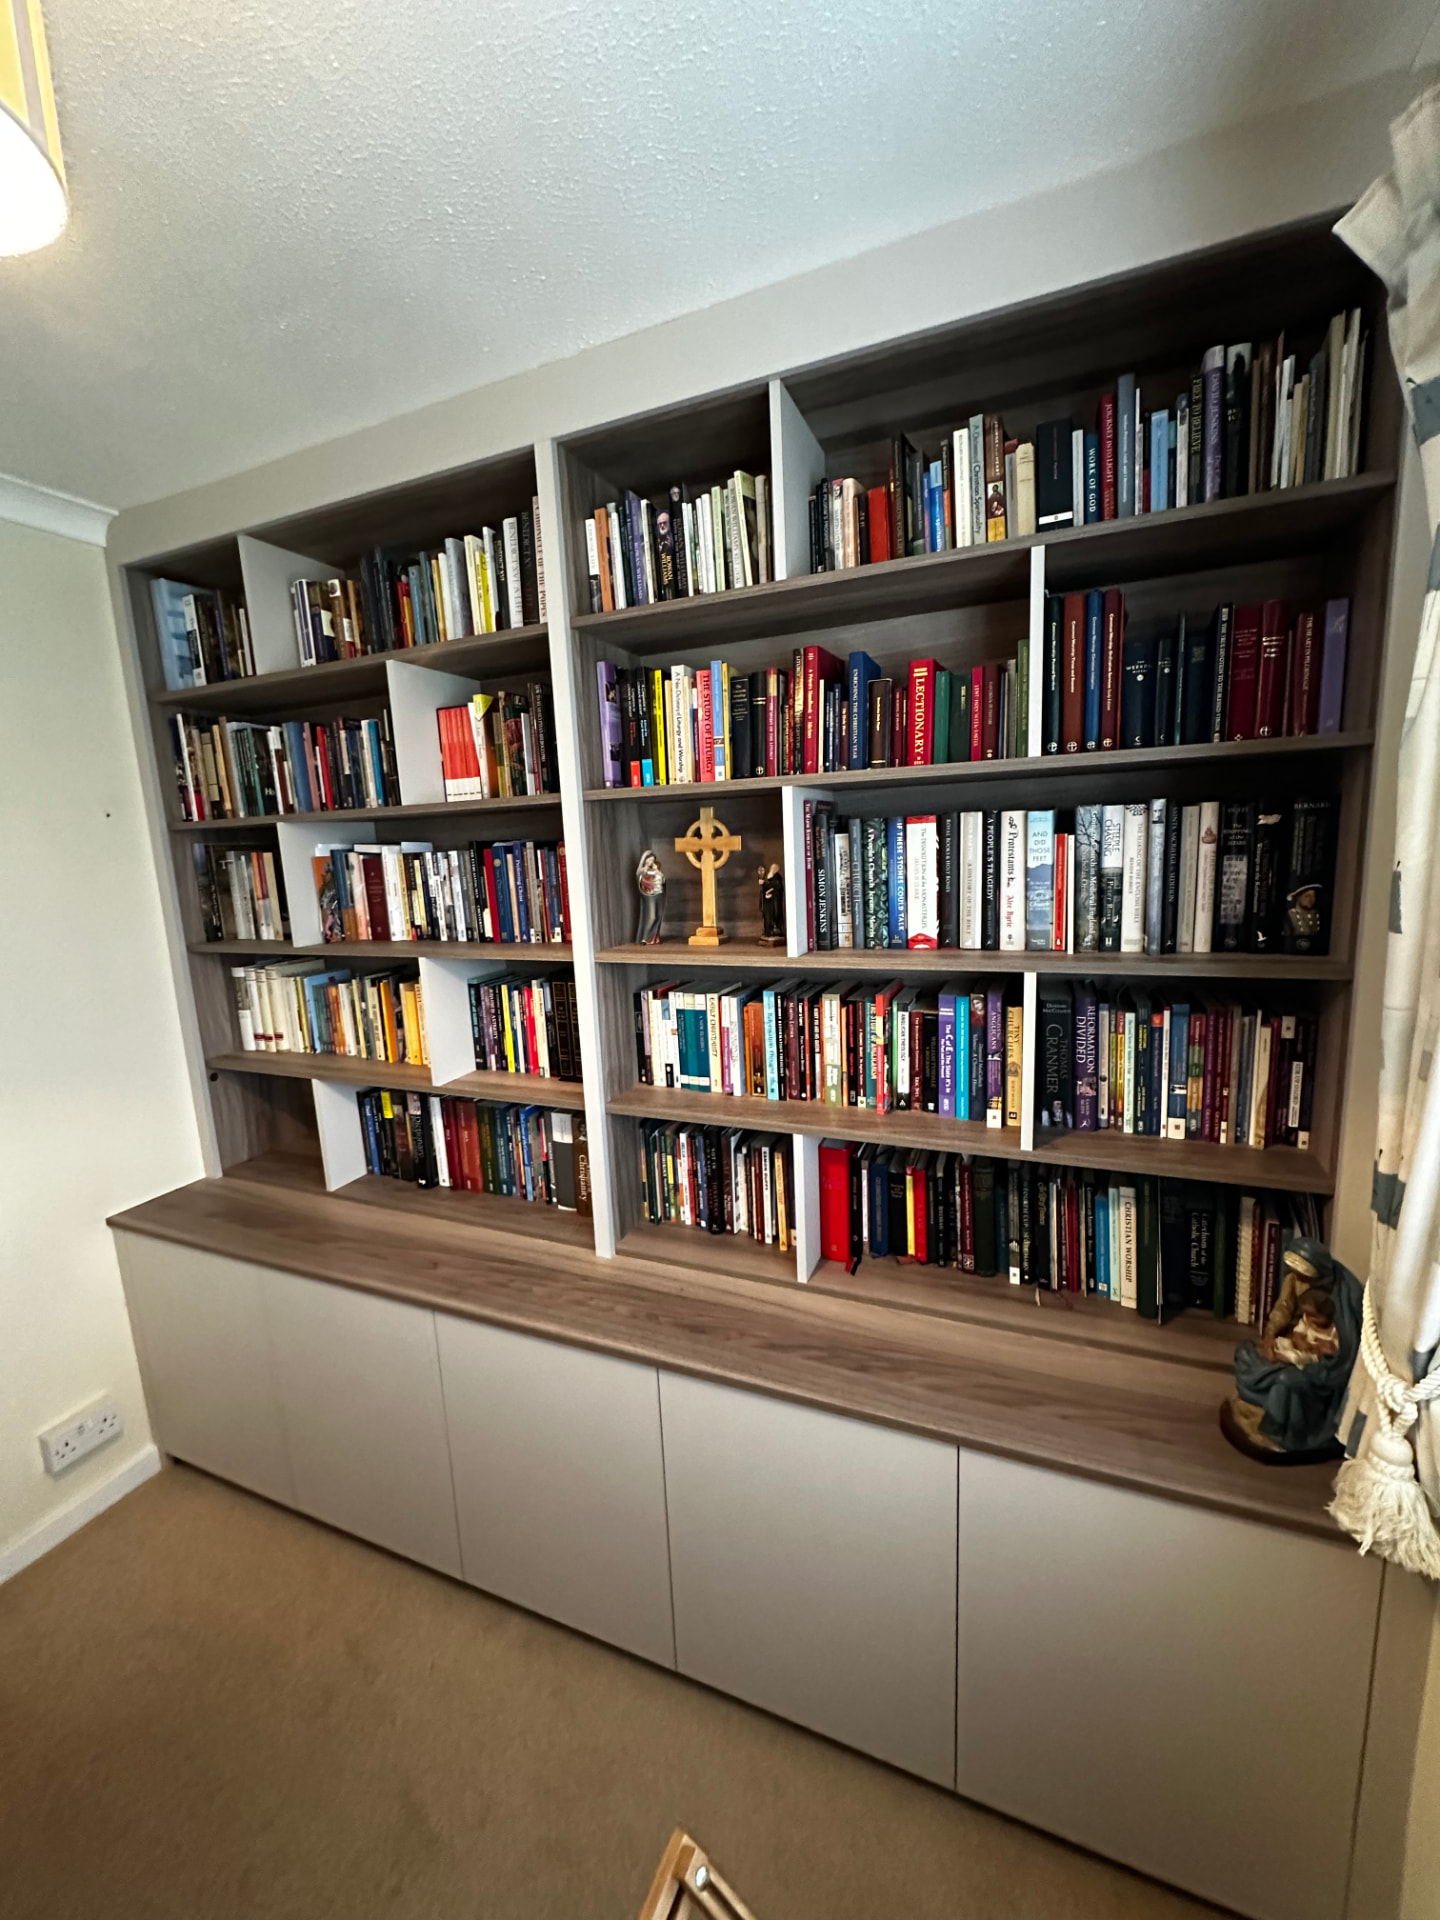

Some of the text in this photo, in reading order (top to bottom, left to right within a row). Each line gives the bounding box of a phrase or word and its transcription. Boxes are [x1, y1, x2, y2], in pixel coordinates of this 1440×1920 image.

[1088, 448, 1096, 475] WORK
[1089, 478, 1096, 489] OF
[661, 552, 669, 584] WILLIAMS
[702, 674, 713, 775] THE STUDY OF LITURGY
[914, 678, 925, 754] LECTIONARY
[1103, 819, 1111, 857] CHASING
[817, 869, 827, 933] SIMON JENKINS
[1046, 1024, 1063, 1094] CRANMER
[1076, 1016, 1086, 1063] DIVIDED
[1087, 1006, 1095, 1073] REFORMATION
[579, 1155, 587, 1201] Christianity
[1125, 1247, 1133, 1283] WORSHIP
[1190, 1242, 1199, 1267] Church
